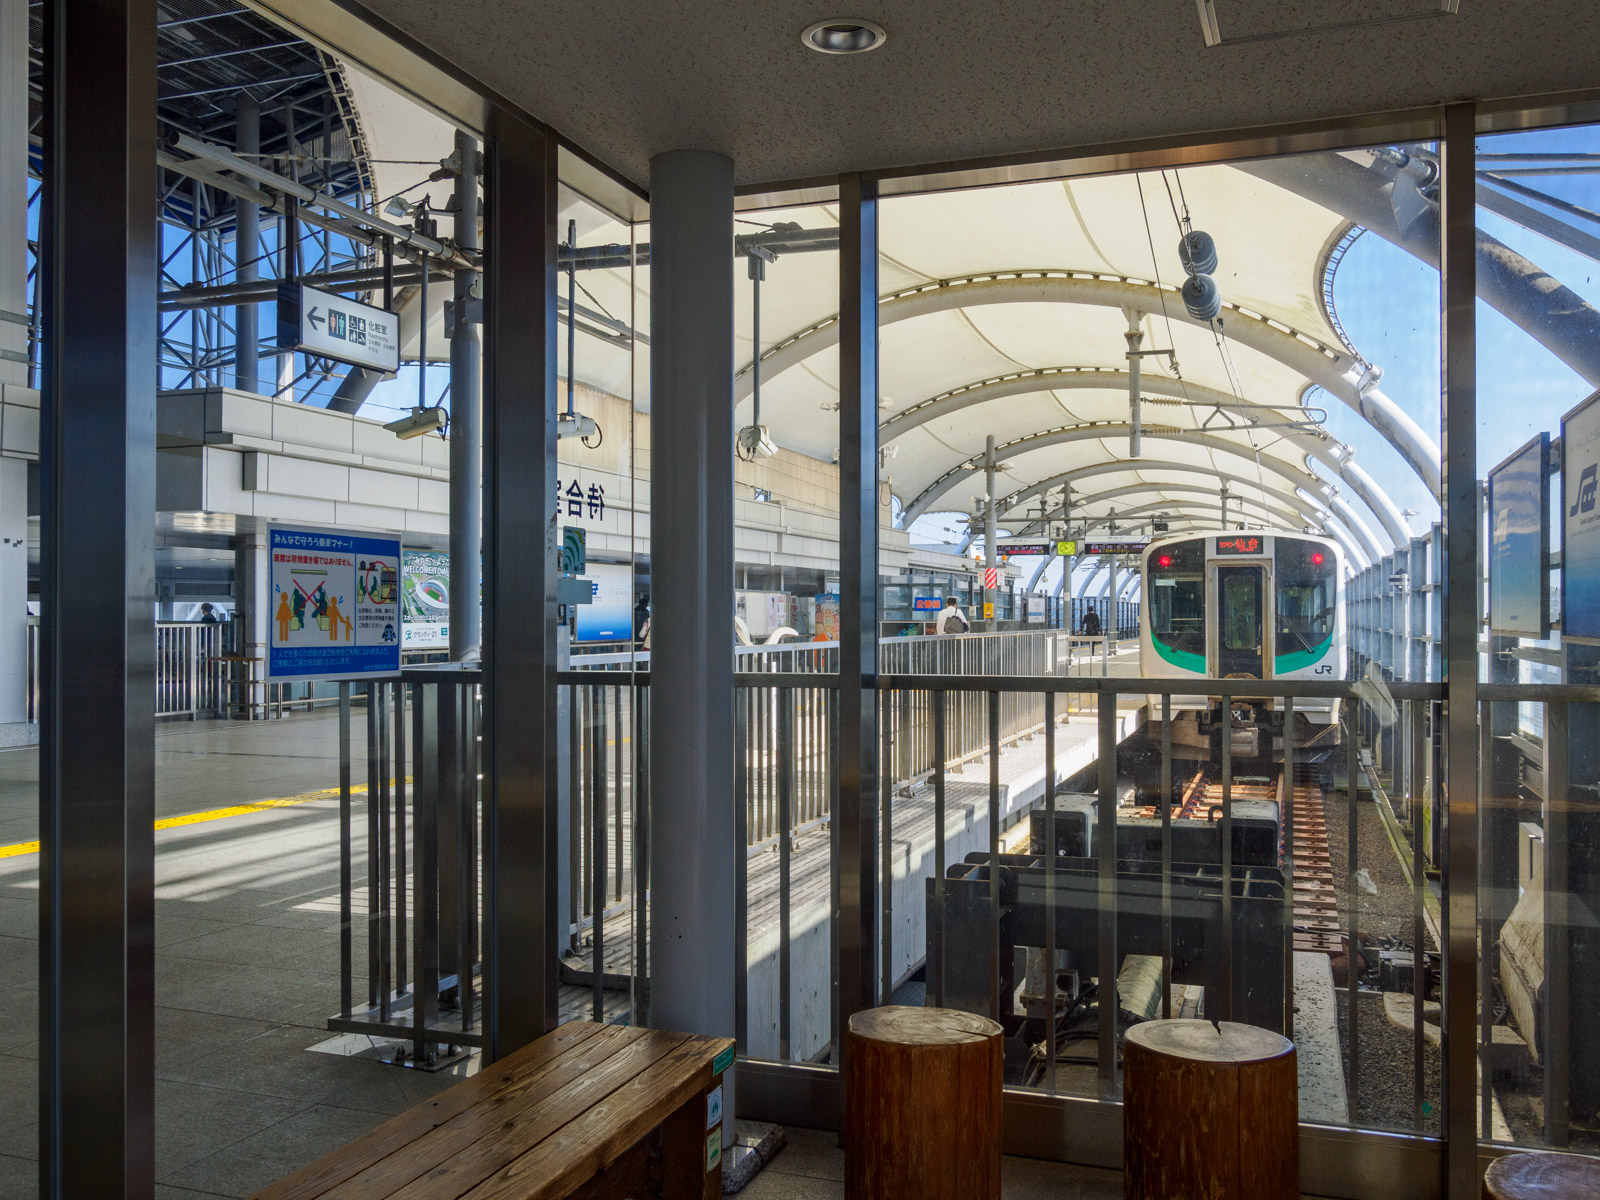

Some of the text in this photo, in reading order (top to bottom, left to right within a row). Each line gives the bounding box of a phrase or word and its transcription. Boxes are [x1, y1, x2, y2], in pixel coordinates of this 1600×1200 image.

[368, 321, 387, 335] 化粧室
[368, 332, 389, 343] Restrooms
[274, 534, 353, 549] みんなで守ろう乗車マナー！
[1235, 538, 1258, 549] 仙台
[274, 554, 354, 567] 座席は荷物置き場ではありません。
[403, 565, 433, 574] WELCOME
[1314, 665, 1332, 674] JR
